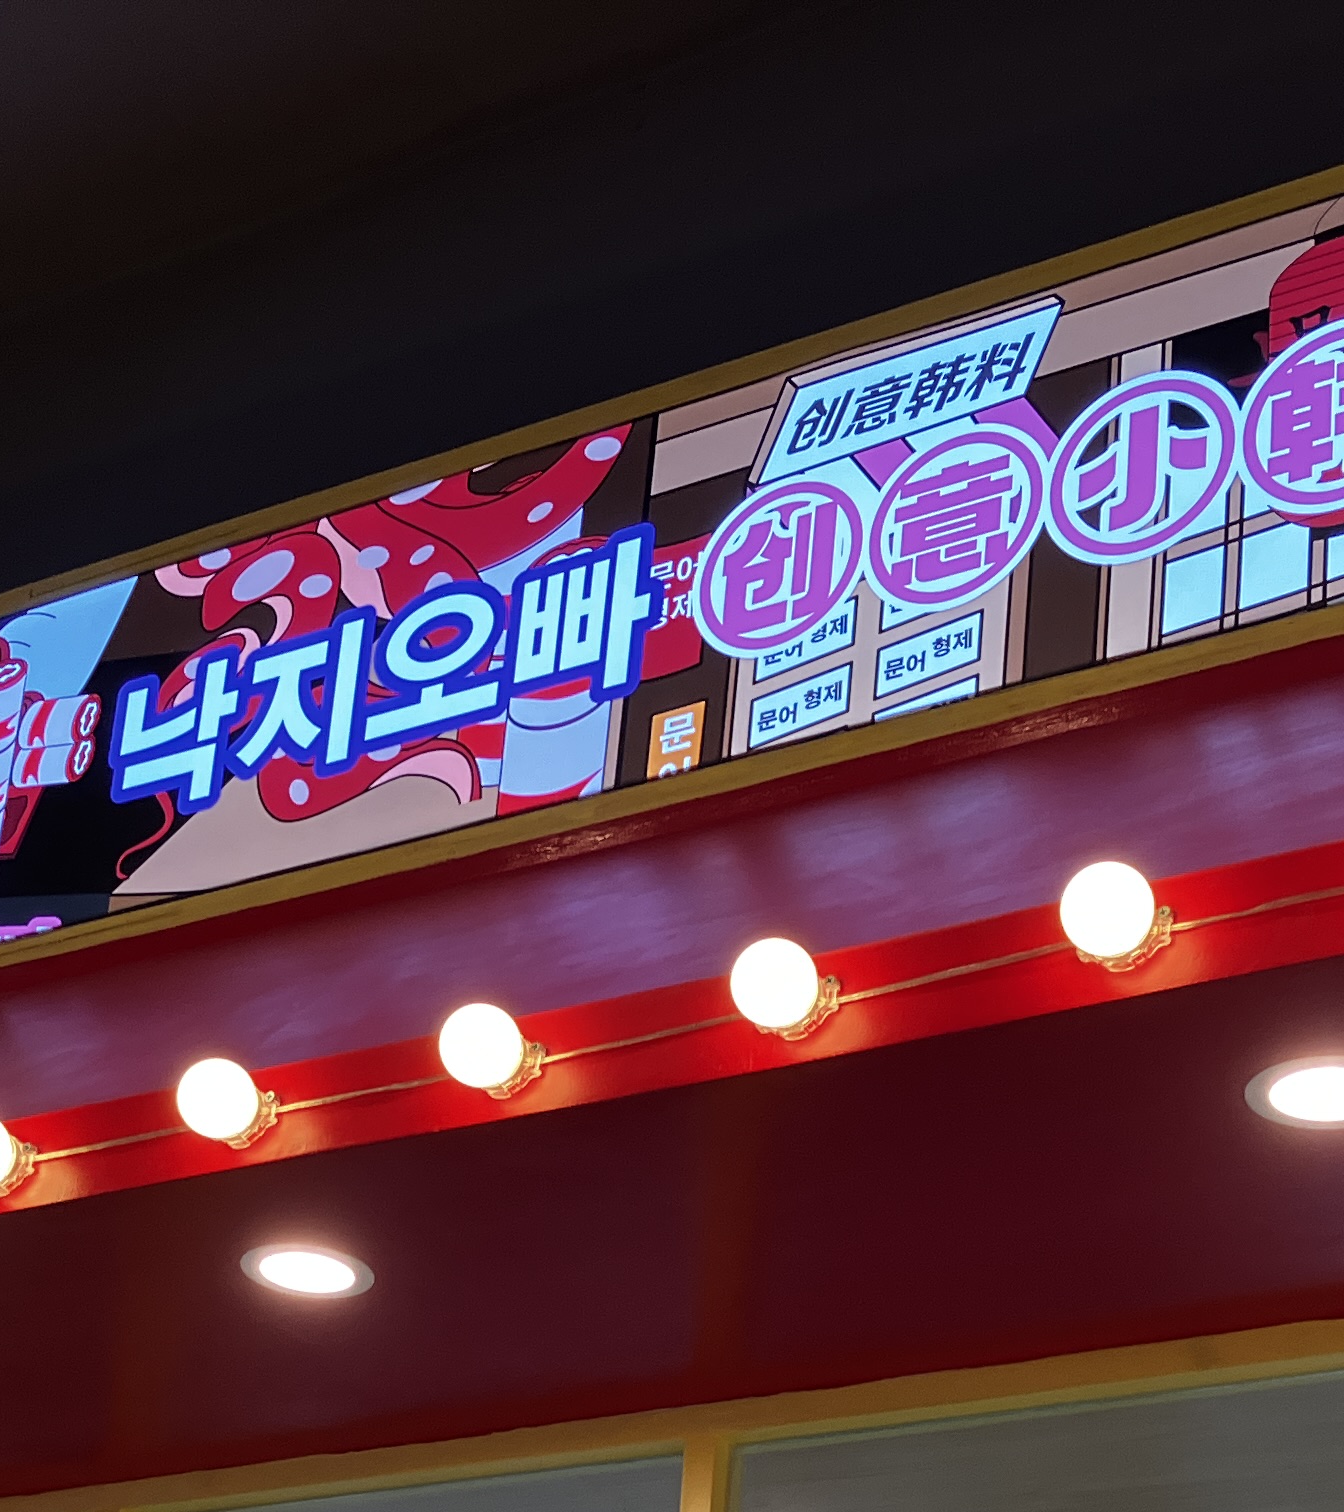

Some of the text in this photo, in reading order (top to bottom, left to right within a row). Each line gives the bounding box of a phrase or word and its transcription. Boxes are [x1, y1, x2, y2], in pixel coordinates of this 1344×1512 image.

[785, 331, 1036, 454] 创意韩料
[116, 530, 652, 808] 낙지오빠
[884, 627, 973, 681] 문어 형제
[757, 680, 843, 733] 문어 형제
